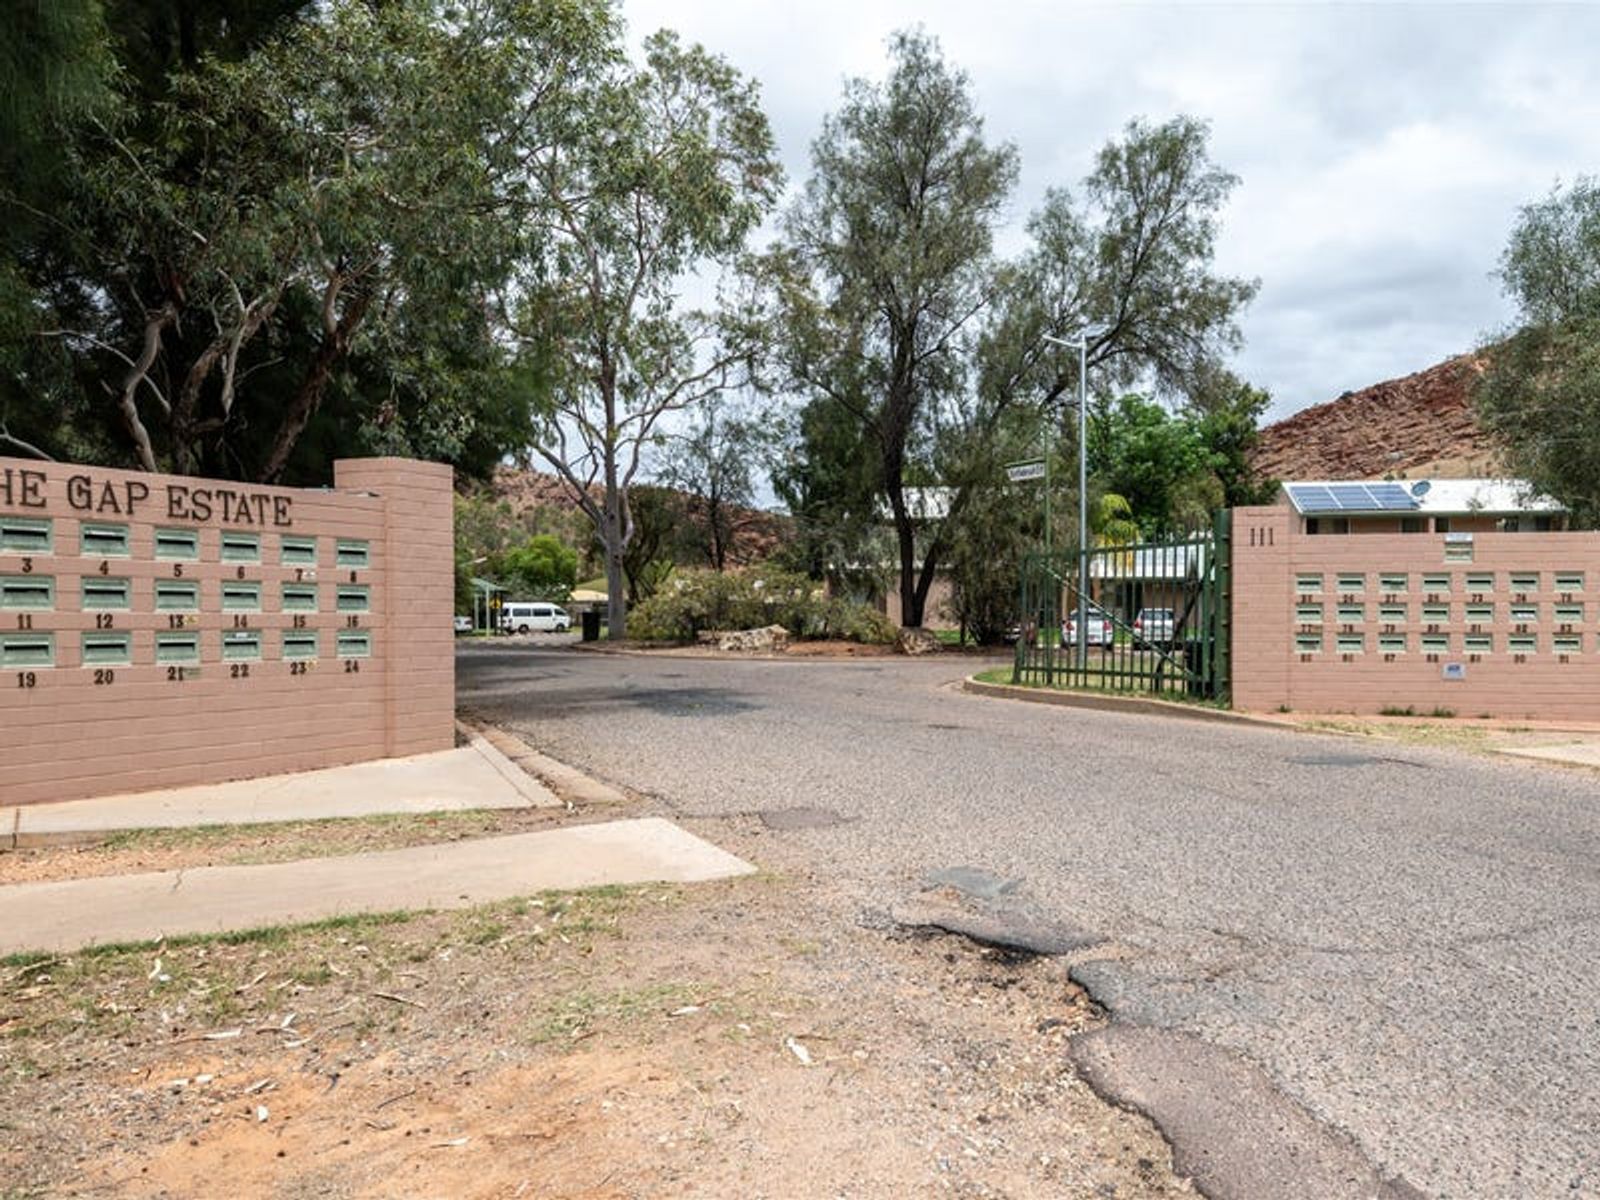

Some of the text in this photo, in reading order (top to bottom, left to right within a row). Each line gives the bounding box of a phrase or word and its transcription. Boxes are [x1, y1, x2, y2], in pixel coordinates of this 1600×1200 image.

[67, 474, 149, 515] GAP
[166, 484, 292, 526] ESTATE
[1250, 527, 1274, 547] 111
[22, 557, 357, 583] 3 4 5 6 7 8
[17, 614, 358, 630] 11 12 13 14 15 16
[17, 660, 359, 688] 19 20 21 22 23 24
